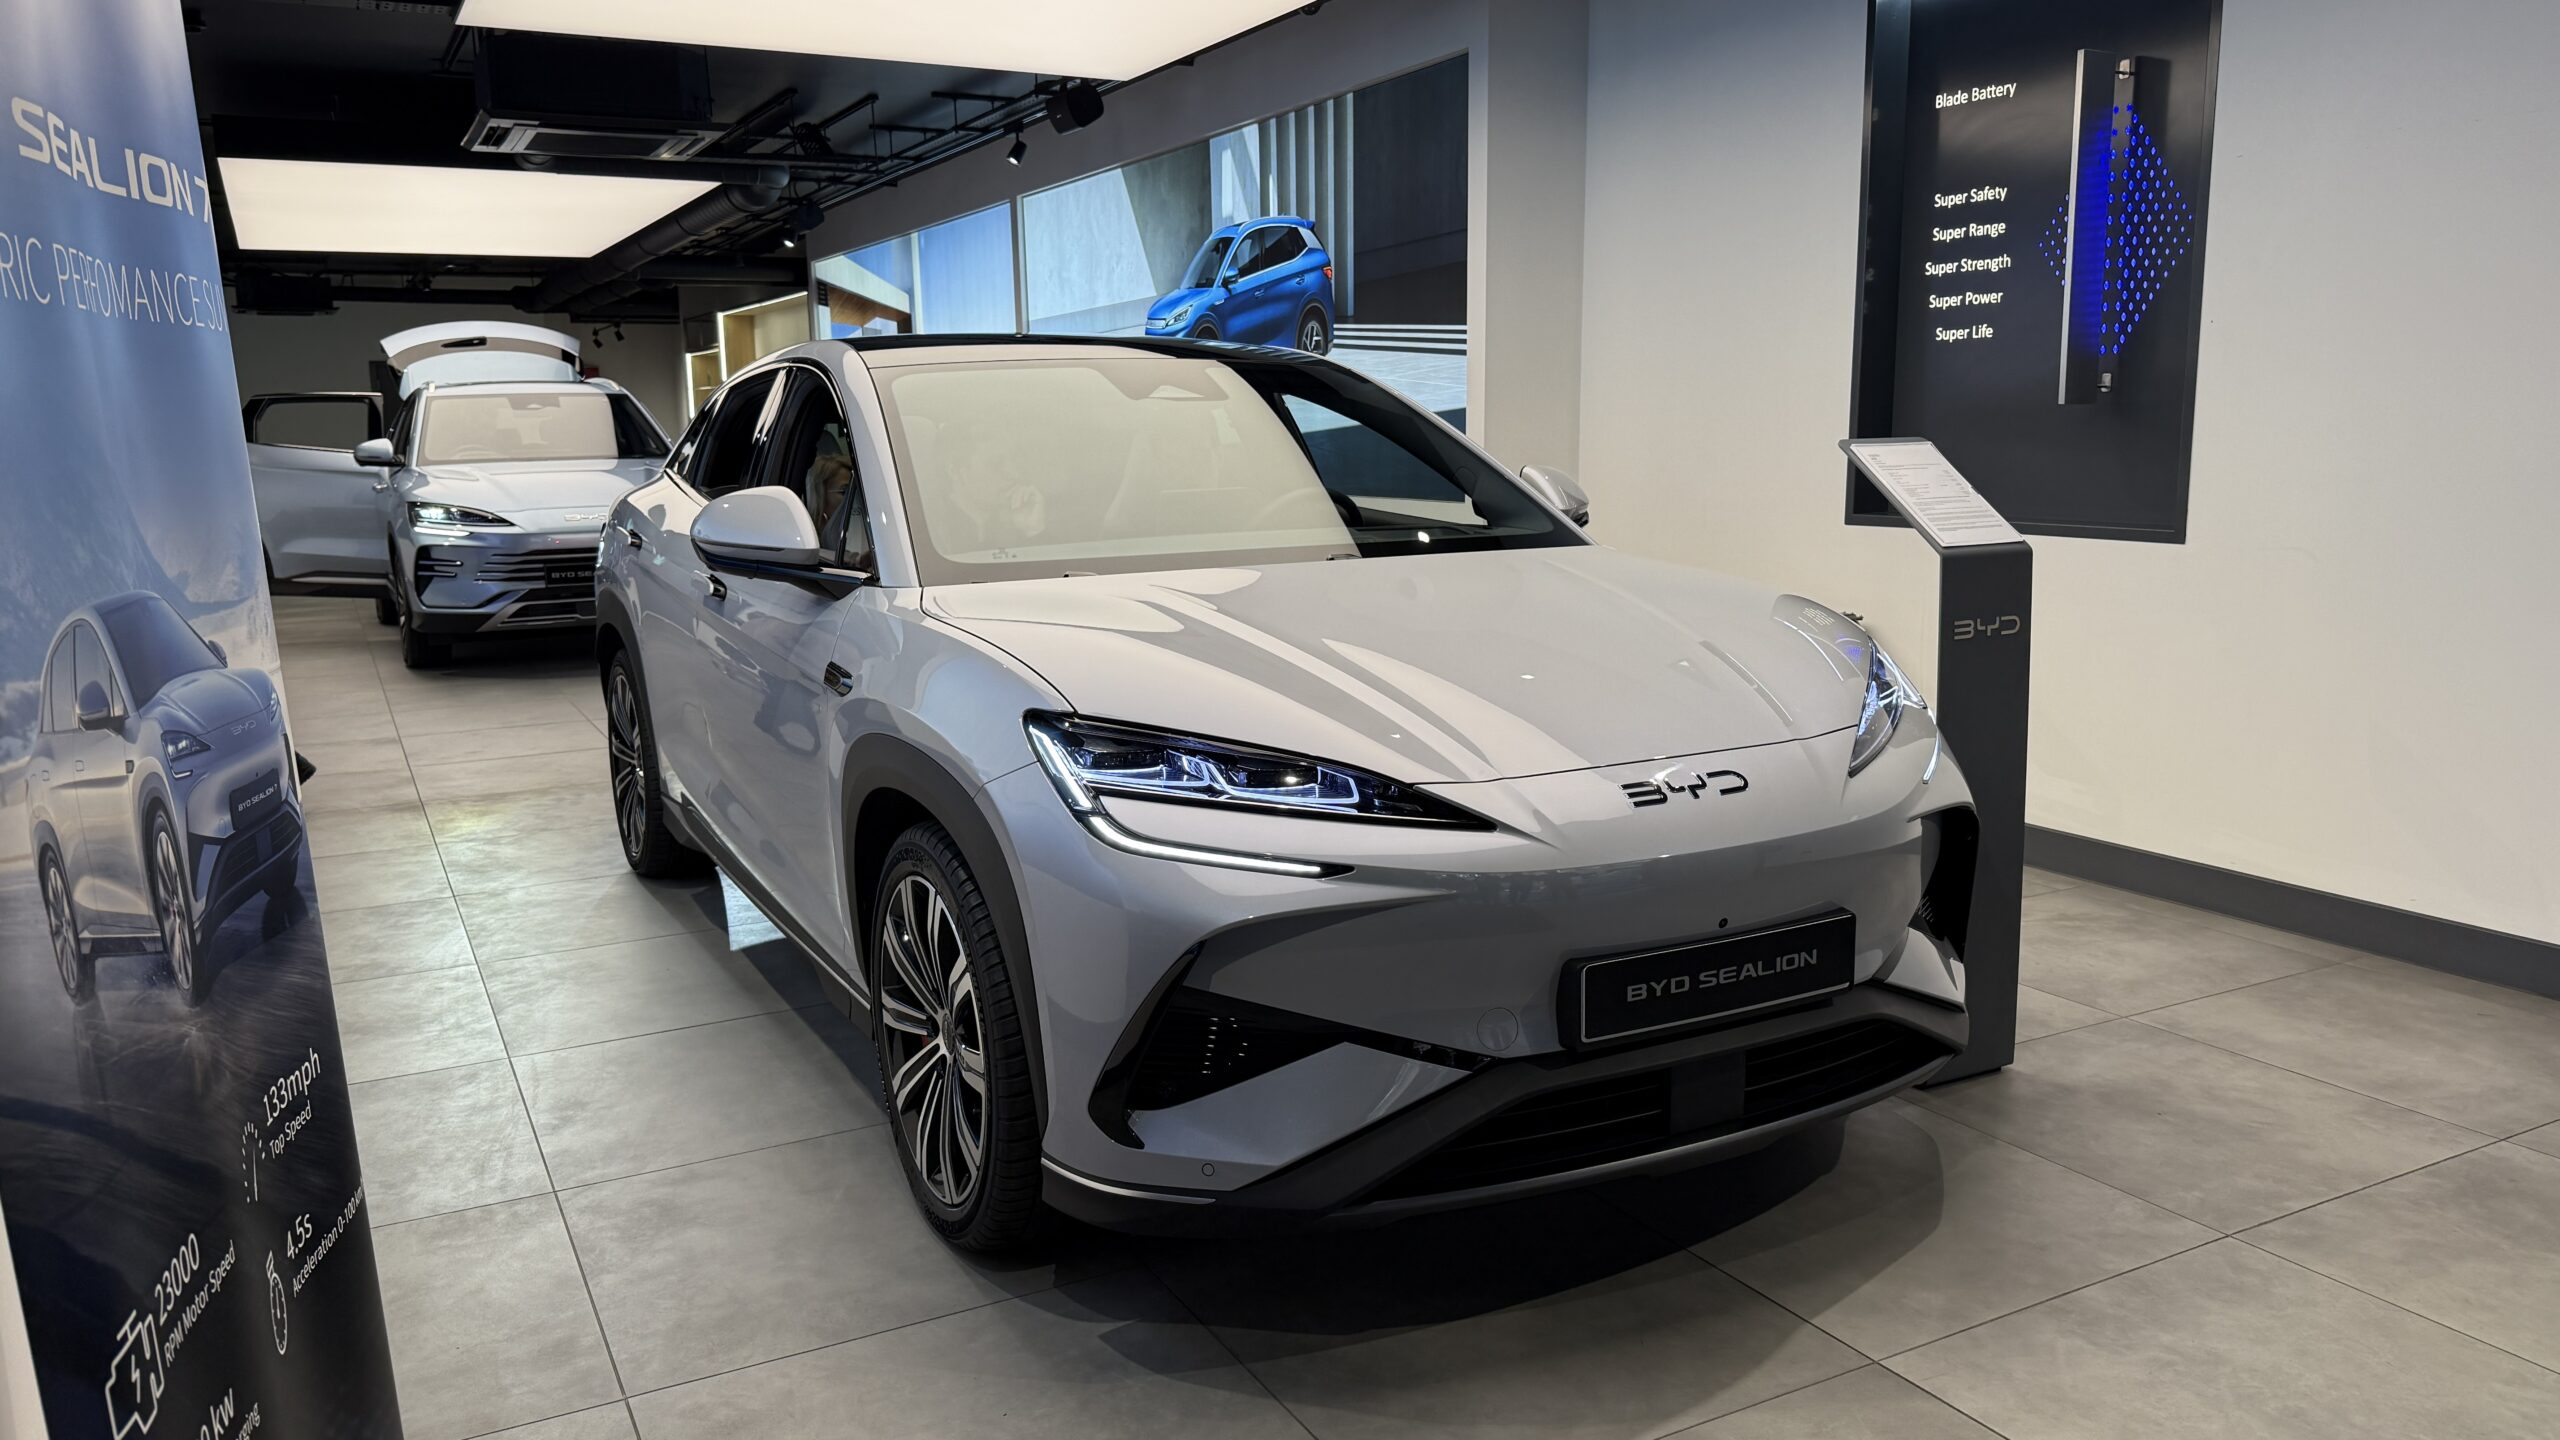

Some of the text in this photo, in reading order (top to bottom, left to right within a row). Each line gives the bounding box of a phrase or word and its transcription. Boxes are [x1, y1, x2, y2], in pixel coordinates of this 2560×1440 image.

[1935, 82, 2017, 109] Blade Battery
[11, 97, 211, 223] SEALION 7
[1934, 185, 2007, 208] Super Safety
[1932, 222, 2006, 242] Super Range
[52, 242, 205, 327] PERFOMANCE
[1925, 254, 2011, 277] Super Strength
[1929, 290, 2003, 310] Super Power
[1935, 324, 1994, 342] Super Life
[1954, 615, 2020, 640] BYD
[1617, 769, 1749, 809] BYD
[1627, 949, 1817, 1002] BYD SEALION
[263, 1047, 321, 1127] 133mph
[269, 1099, 312, 1159] Top Speed
[287, 1213, 313, 1260] 4.5s
[292, 1227, 339, 1298] Acceleration
[337, 1197, 356, 1234] 0-100
[155, 1233, 200, 1327] 23000
[163, 1239, 236, 1368] RPM Motor Speed
